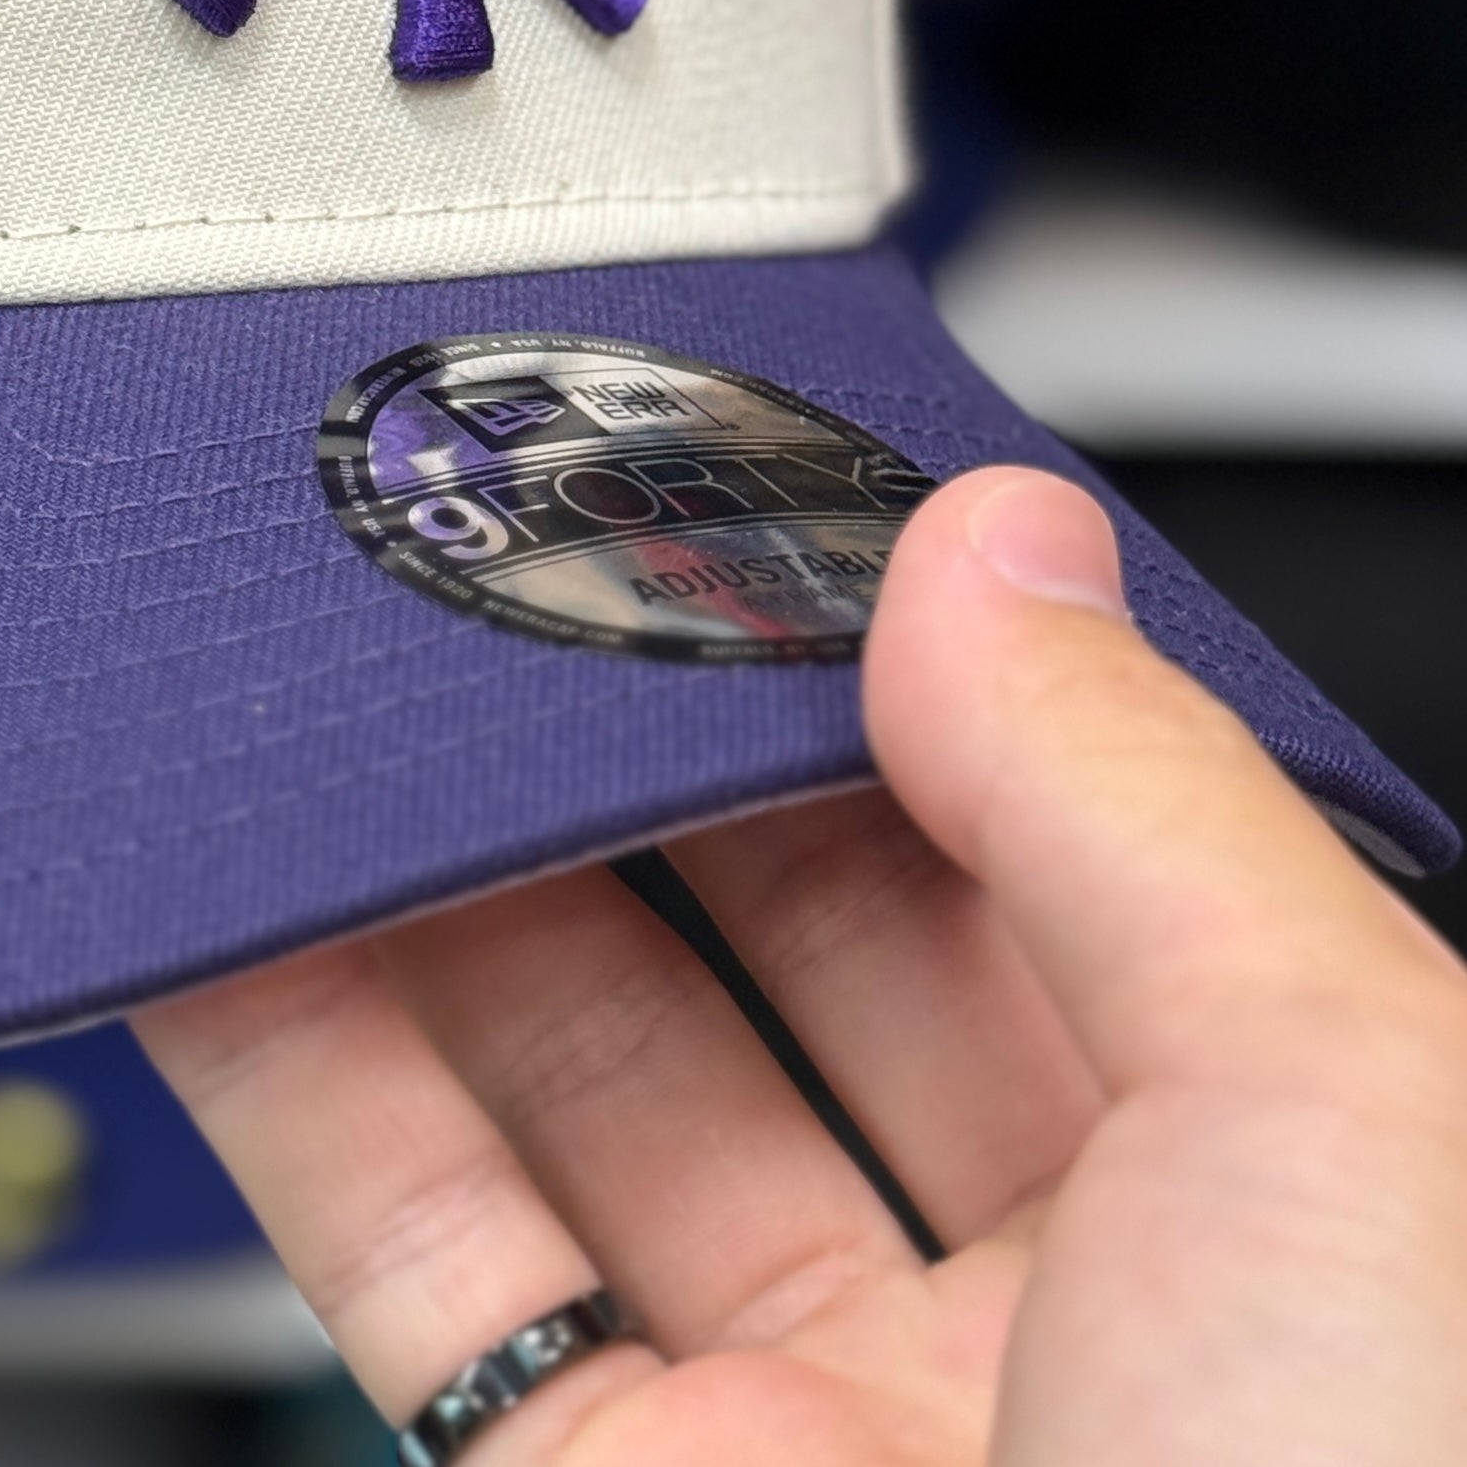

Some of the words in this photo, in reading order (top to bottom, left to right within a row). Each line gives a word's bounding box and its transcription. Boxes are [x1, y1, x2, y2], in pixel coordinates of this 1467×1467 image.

[572, 381, 666, 402] NEW
[595, 399, 691, 420] ERA
[362, 517, 386, 538] USA
[398, 550, 437, 579] SINCE
[436, 575, 474, 600] 1920
